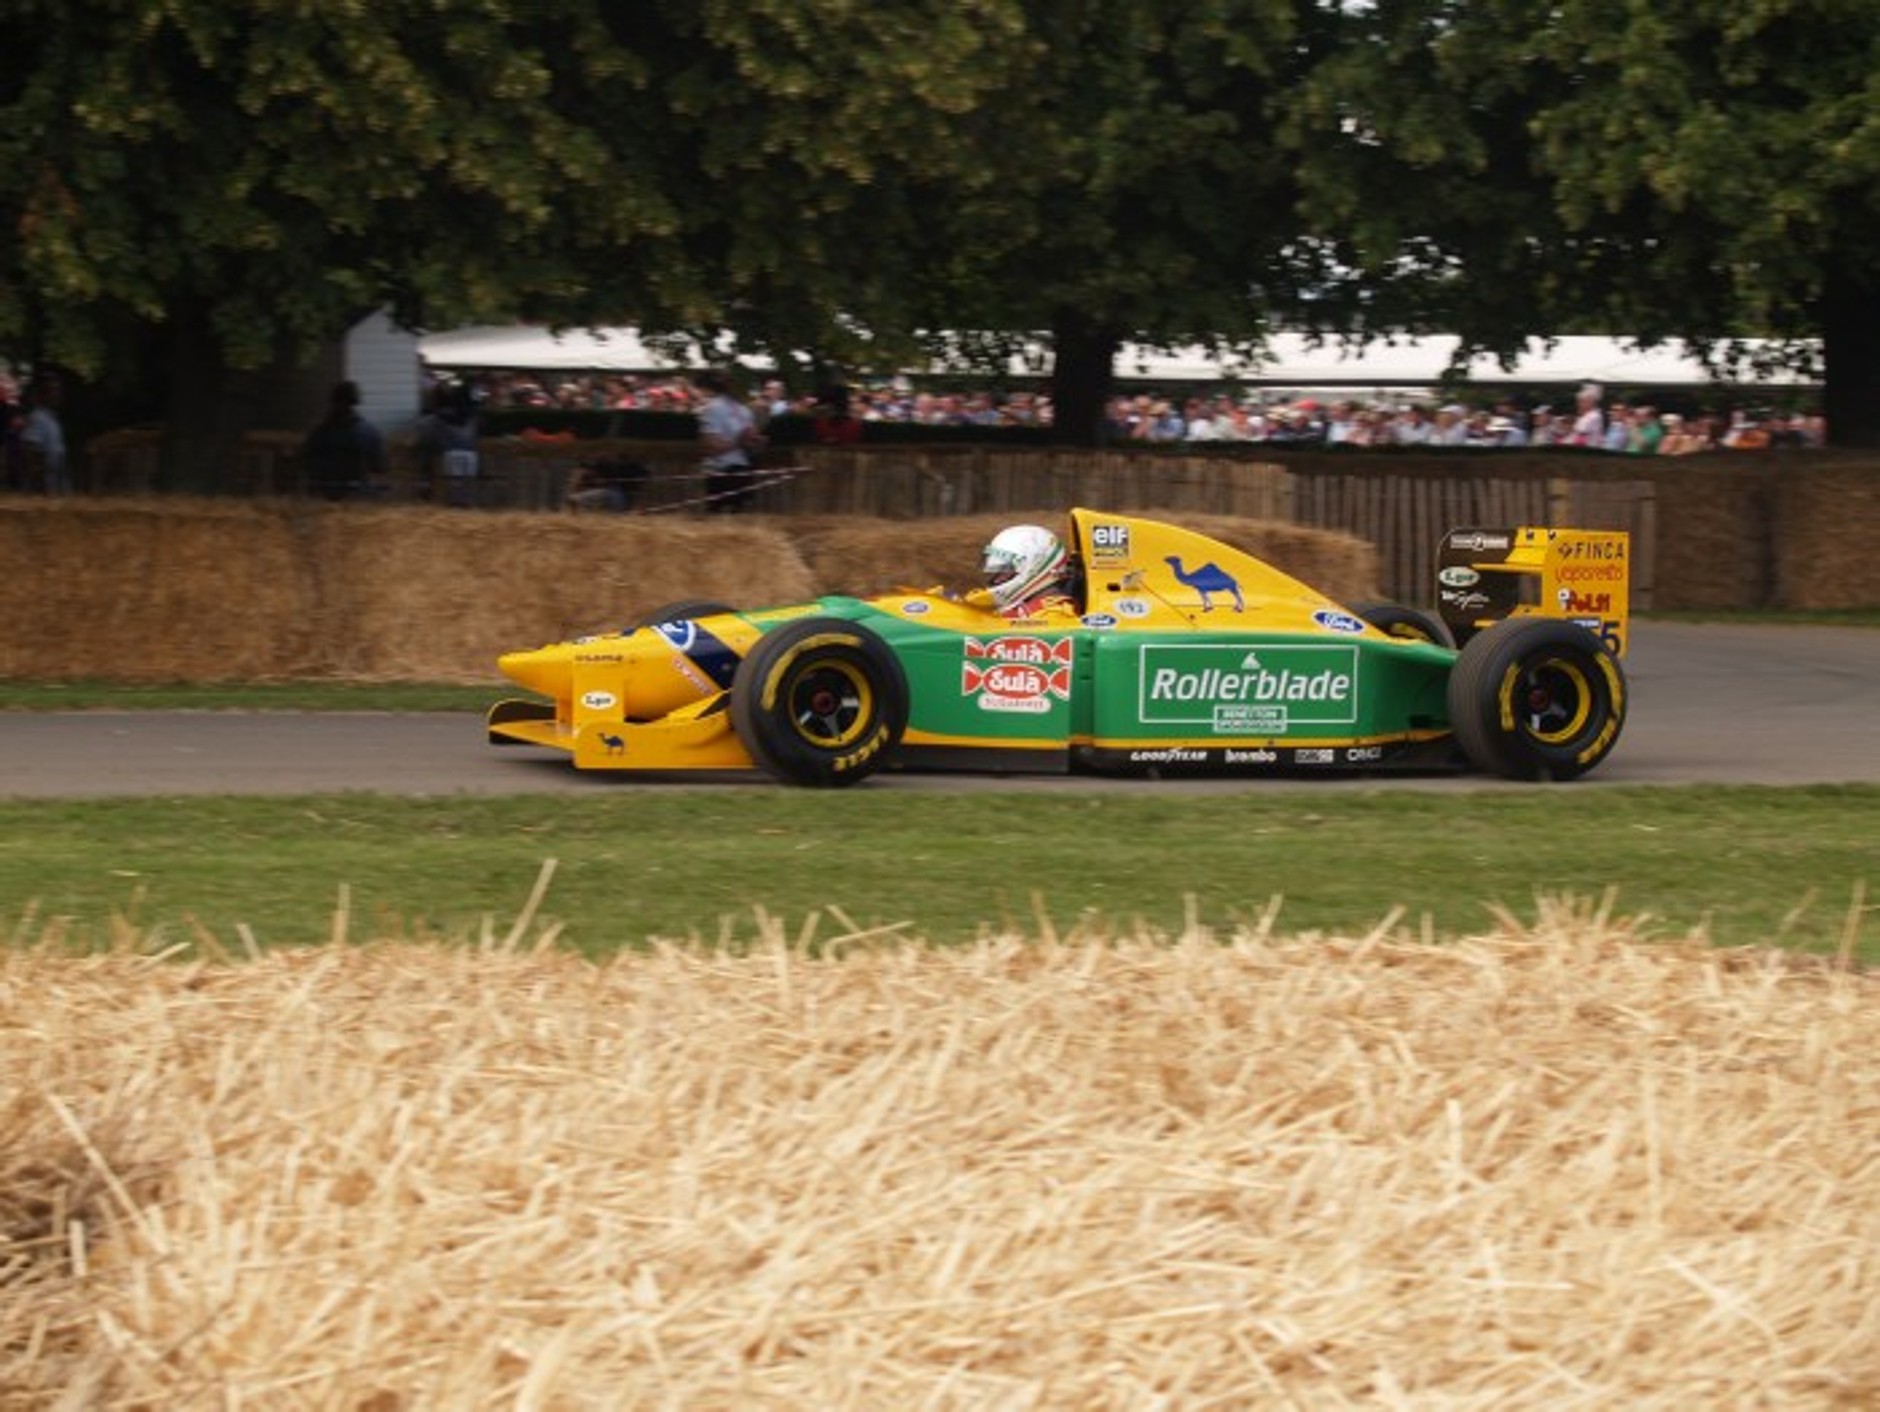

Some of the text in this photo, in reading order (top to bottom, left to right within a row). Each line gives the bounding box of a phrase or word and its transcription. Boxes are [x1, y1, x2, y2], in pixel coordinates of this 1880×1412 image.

[1095, 528, 1128, 545] elf
[1574, 543, 1623, 558] FINCA
[1151, 669, 1349, 700] Rollerblade
[1131, 748, 1207, 763] GOODYEAR
[1225, 748, 1277, 763] brembo
